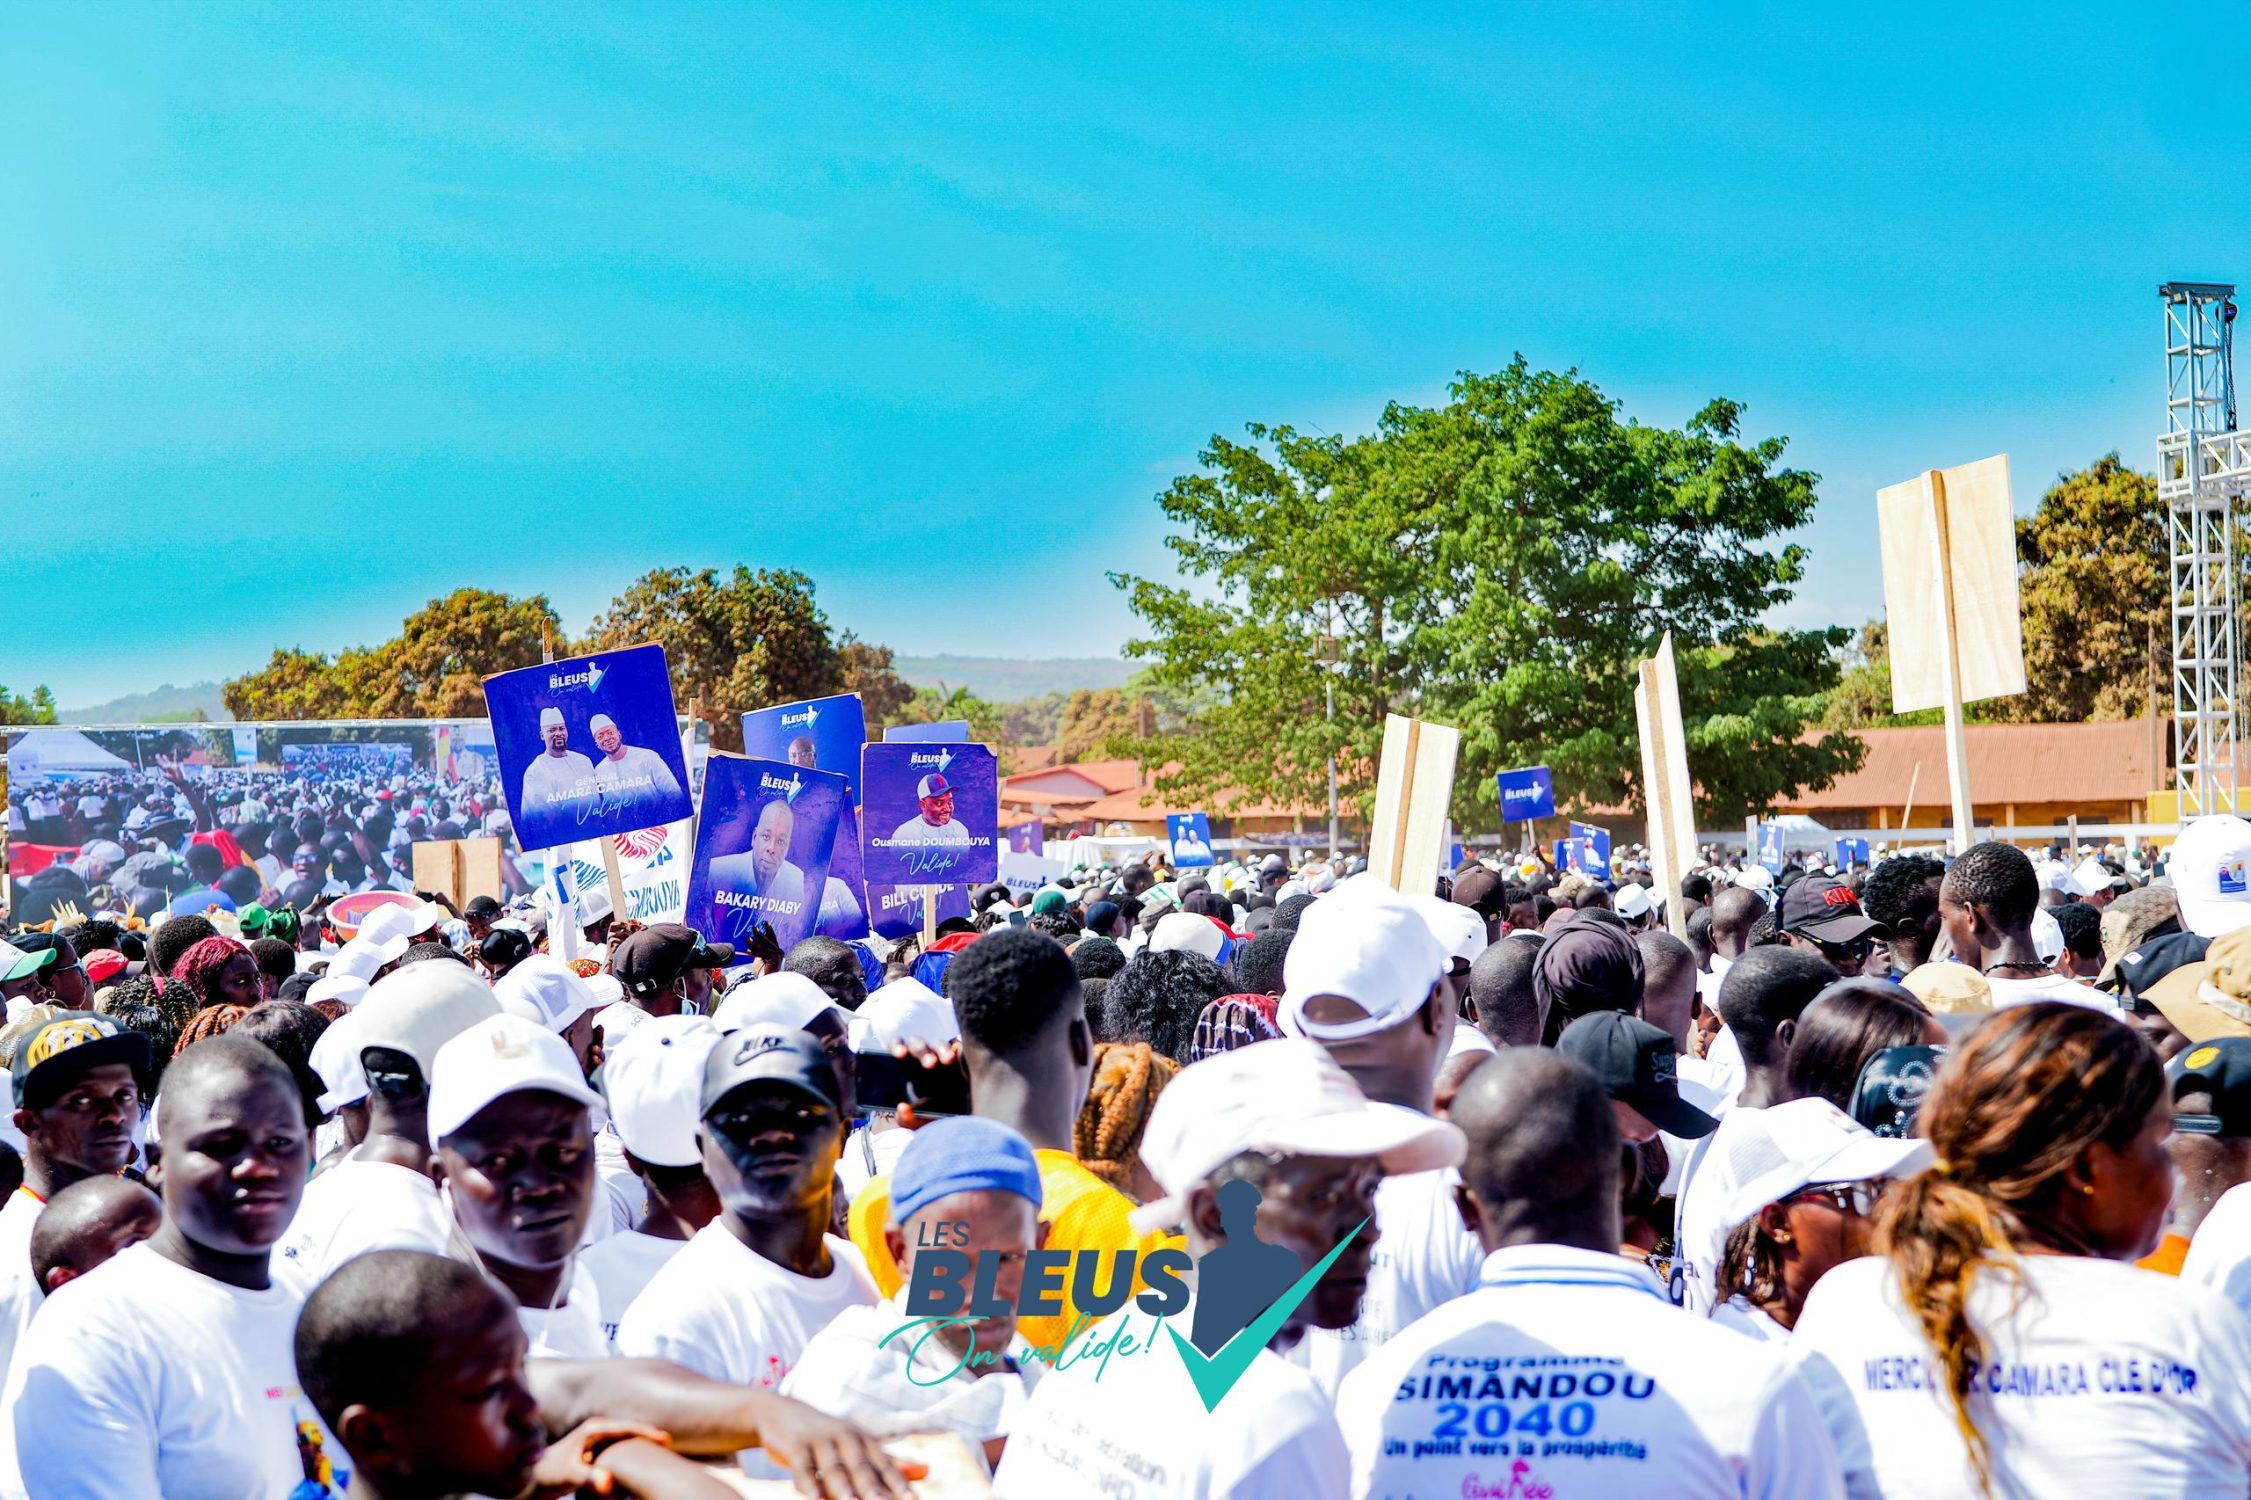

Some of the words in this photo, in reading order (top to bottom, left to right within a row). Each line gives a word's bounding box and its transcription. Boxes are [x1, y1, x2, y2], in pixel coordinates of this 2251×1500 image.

[549, 672, 588, 689] BLEUS
[781, 713, 808, 725] BLEUS
[911, 753, 940, 764] BLEUS
[546, 785, 592, 804] AMARA
[597, 775, 652, 794] CAMARA
[760, 775, 791, 791] BLEUS
[1505, 787, 1532, 801] BLEUS
[561, 793, 638, 826] Valide!
[872, 837, 920, 847] Ousmane
[922, 836, 991, 847] DOUMBOUYA
[900, 847, 960, 876] Valide!
[714, 890, 767, 910] BAKARY
[767, 898, 802, 915] DIABY
[881, 890, 908, 910] BILL
[1396, 1372, 1656, 1401] SIMANDOU
[1432, 1401, 1597, 1438] 2040
[1468, 1440, 1510, 1457] vers
